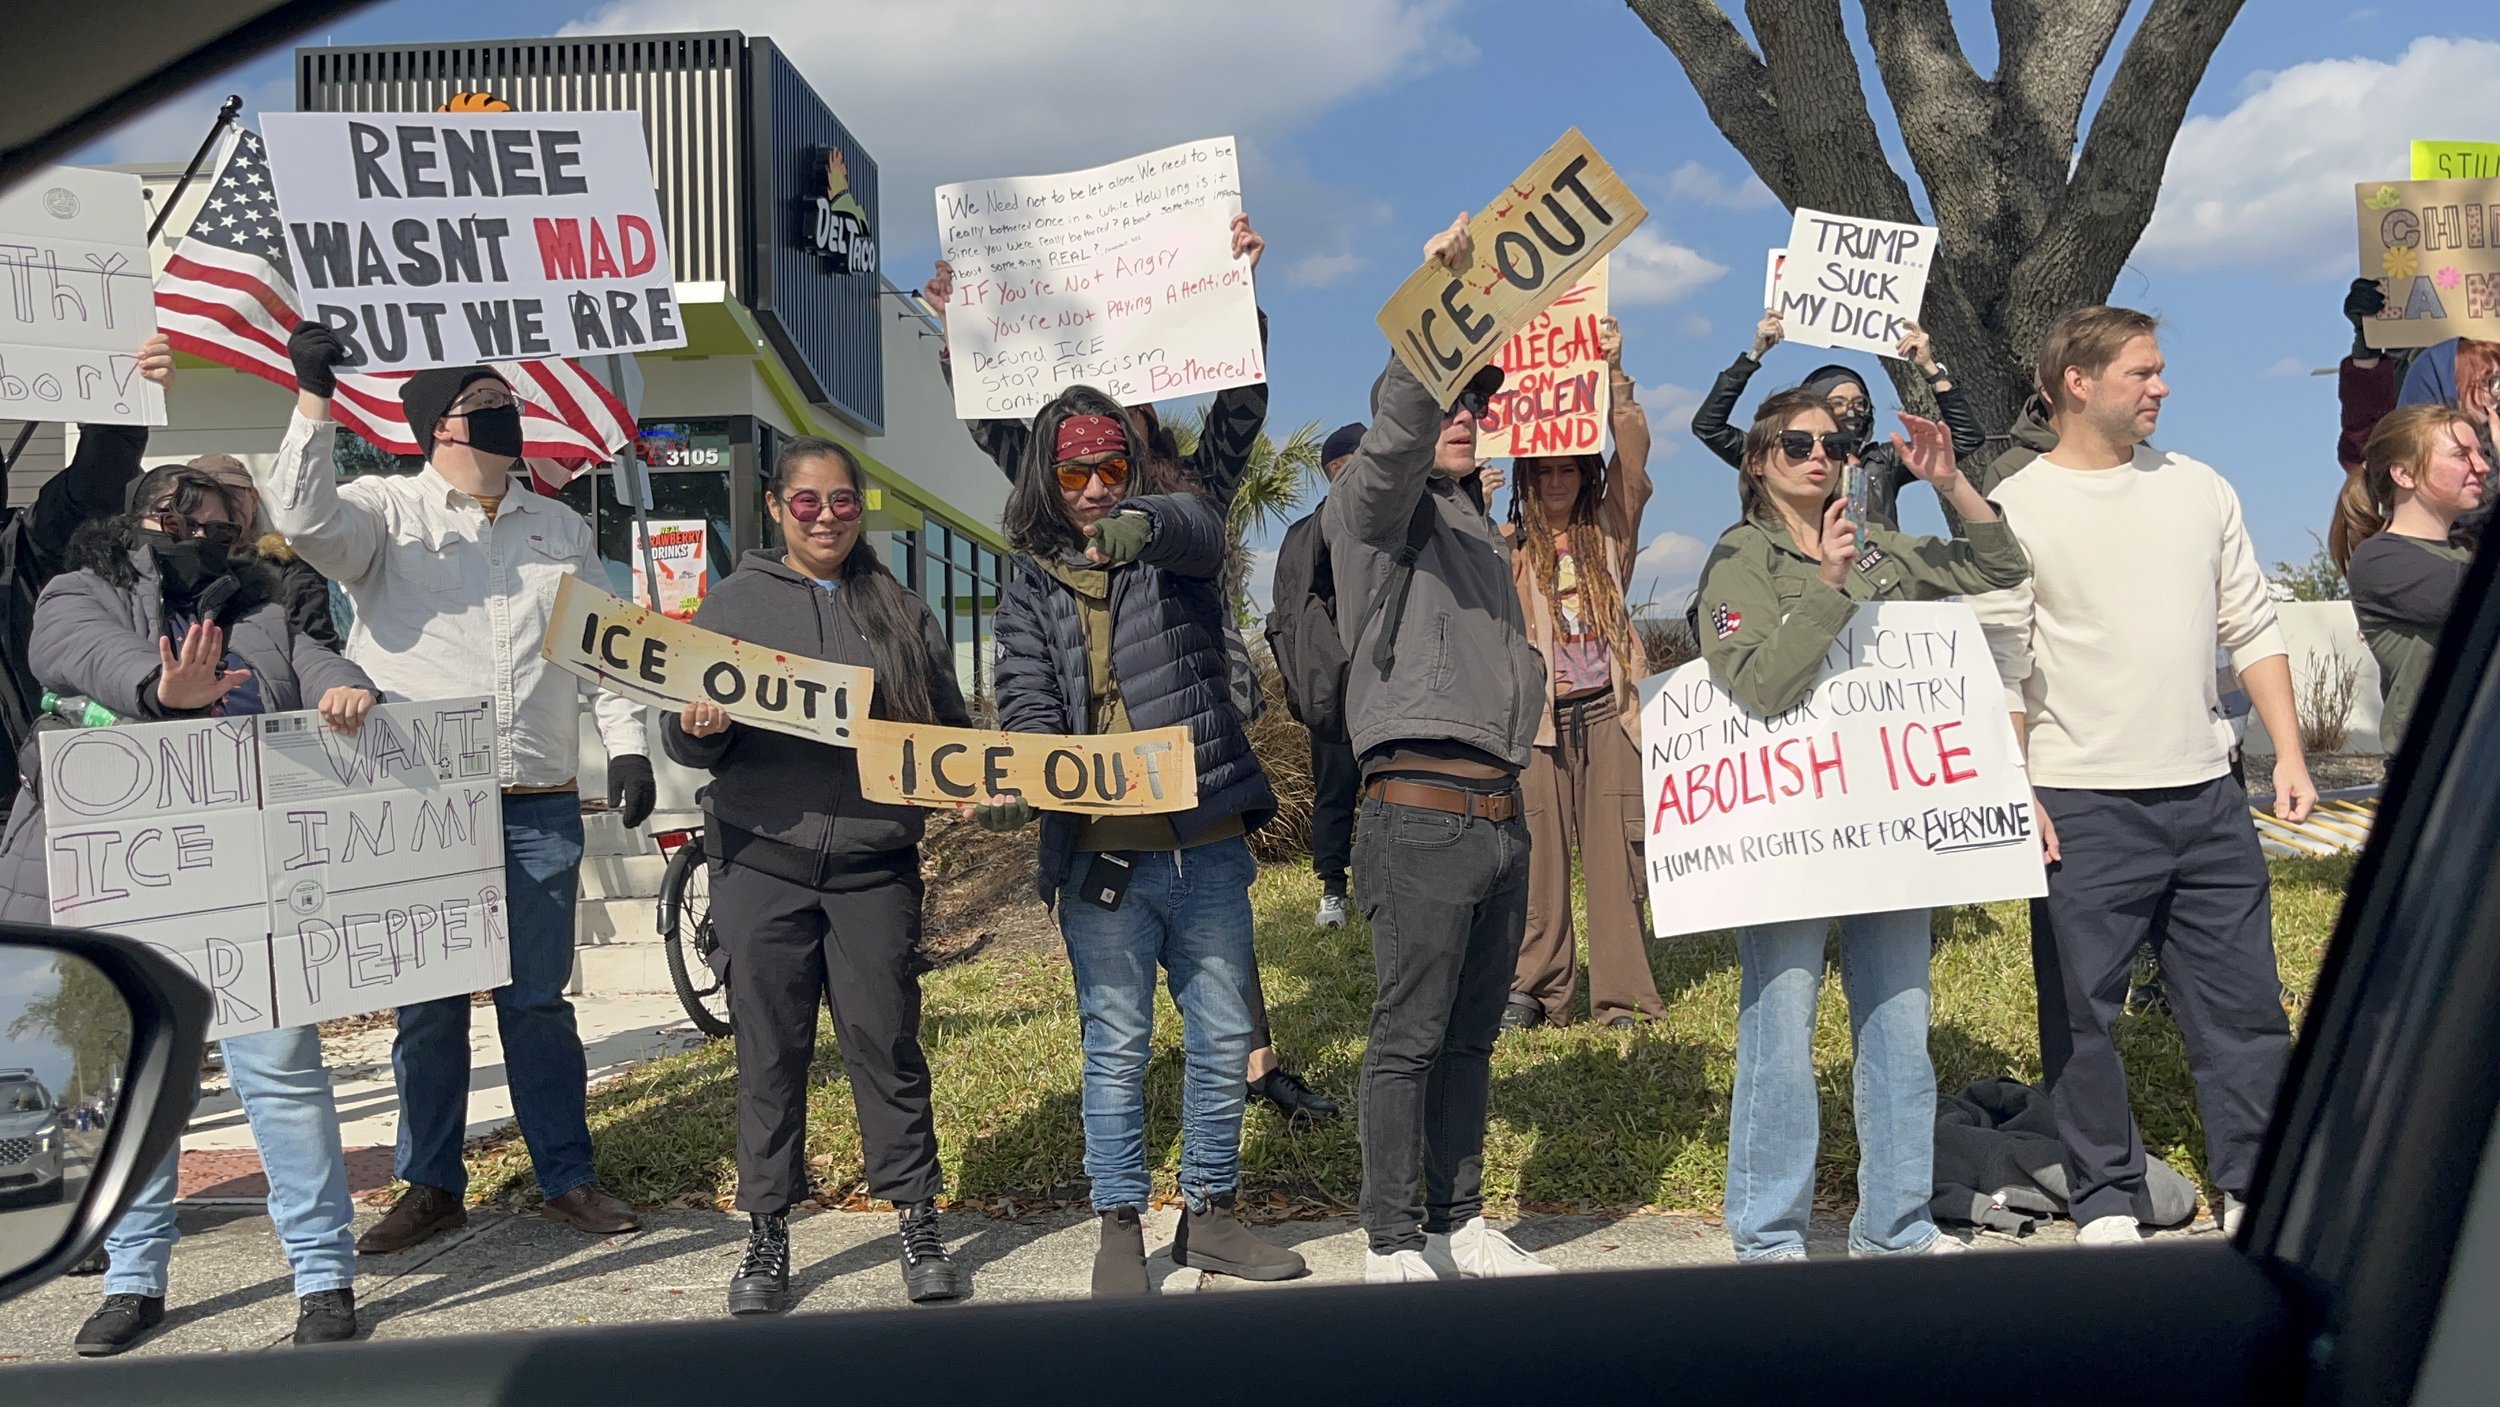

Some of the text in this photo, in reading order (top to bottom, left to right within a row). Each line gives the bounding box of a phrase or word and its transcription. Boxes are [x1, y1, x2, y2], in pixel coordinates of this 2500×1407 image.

[349, 121, 588, 199] RENEE
[1026, 195, 1047, 208] not
[1051, 188, 1065, 203] to
[1069, 187, 1085, 201] be
[1088, 182, 1104, 197] let
[1137, 160, 1156, 180] We
[1162, 154, 1187, 173] need
[1191, 148, 1207, 162] to
[1215, 147, 1232, 158] be
[2438, 152, 2500, 179] STI
[817, 197, 847, 254] DEL
[947, 247, 980, 262] Since
[1039, 234, 1065, 246] really
[1122, 210, 1152, 230] About
[949, 225, 984, 242] really
[990, 221, 1031, 235] bothered
[1068, 215, 1080, 223] in
[1165, 182, 1190, 199] long
[1196, 174, 1208, 189] is
[1213, 171, 1228, 184] it
[2380, 203, 2500, 251] CHI
[533, 214, 656, 281] MAD
[845, 218, 875, 273] TACO
[949, 265, 982, 280] About
[990, 258, 1042, 272] something
[1404, 154, 1614, 383] ICE OUT
[987, 313, 1052, 343] You're
[1058, 308, 1097, 328] Not
[1166, 266, 1250, 305] Attention!
[1000, 278, 1055, 306] You're
[1065, 270, 1105, 294] Not
[1115, 247, 1180, 279] Angry
[1817, 262, 1900, 304] SUCK
[317, 288, 679, 368] BUT WE ARE
[1487, 313, 1606, 374] LLEGAL
[1781, 290, 1907, 343] MY DICK
[973, 336, 1105, 374] Defund ICE
[1108, 377, 1137, 399] Be
[1150, 347, 1263, 393] Bothered!
[1519, 371, 1555, 394] ON
[1478, 369, 1599, 434] STOLEN
[666, 447, 719, 466] 3105
[1509, 417, 1599, 456] LAND
[637, 530, 703, 550] SRAWBERRY
[651, 544, 689, 561] DRINKS
[1856, 550, 1882, 572] LOVE
[581, 612, 851, 738] ICE OUT!
[1826, 628, 1957, 670] Y CITY
[1651, 675, 1967, 771] NOT IN OUR COUNTRY
[51, 707, 485, 816] ONLY WANT
[904, 739, 1174, 802] ICE OUT
[1653, 720, 1979, 836] ABOLISH ICE
[52, 789, 488, 914] ICE IN MY
[1652, 802, 2031, 884] HUMAN RIGHTS ARE FOR EVERYONE
[298, 884, 506, 1005] PEPPER
